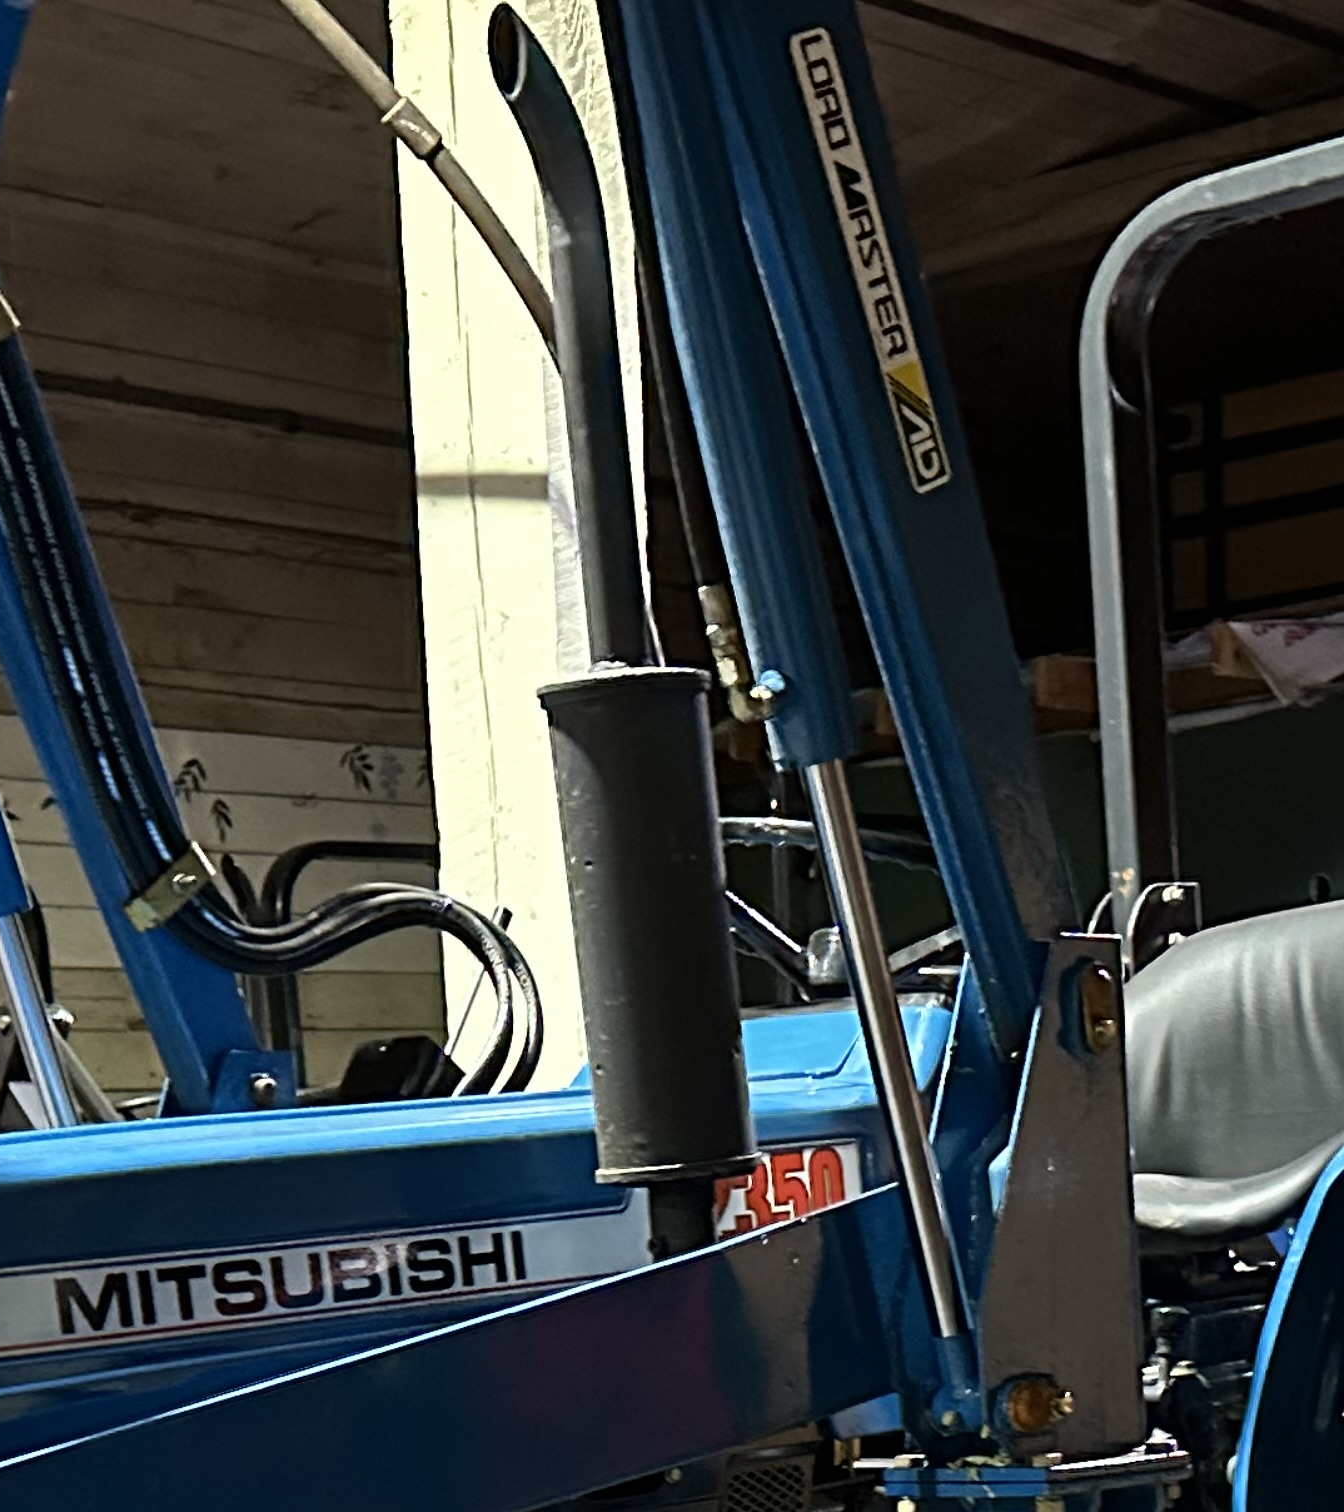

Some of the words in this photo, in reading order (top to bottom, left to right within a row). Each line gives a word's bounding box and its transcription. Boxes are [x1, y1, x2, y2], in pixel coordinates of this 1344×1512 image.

[800, 34, 851, 151] LOAD
[834, 160, 908, 358] MASTER
[54, 1230, 528, 1334] MITSUBISHI
